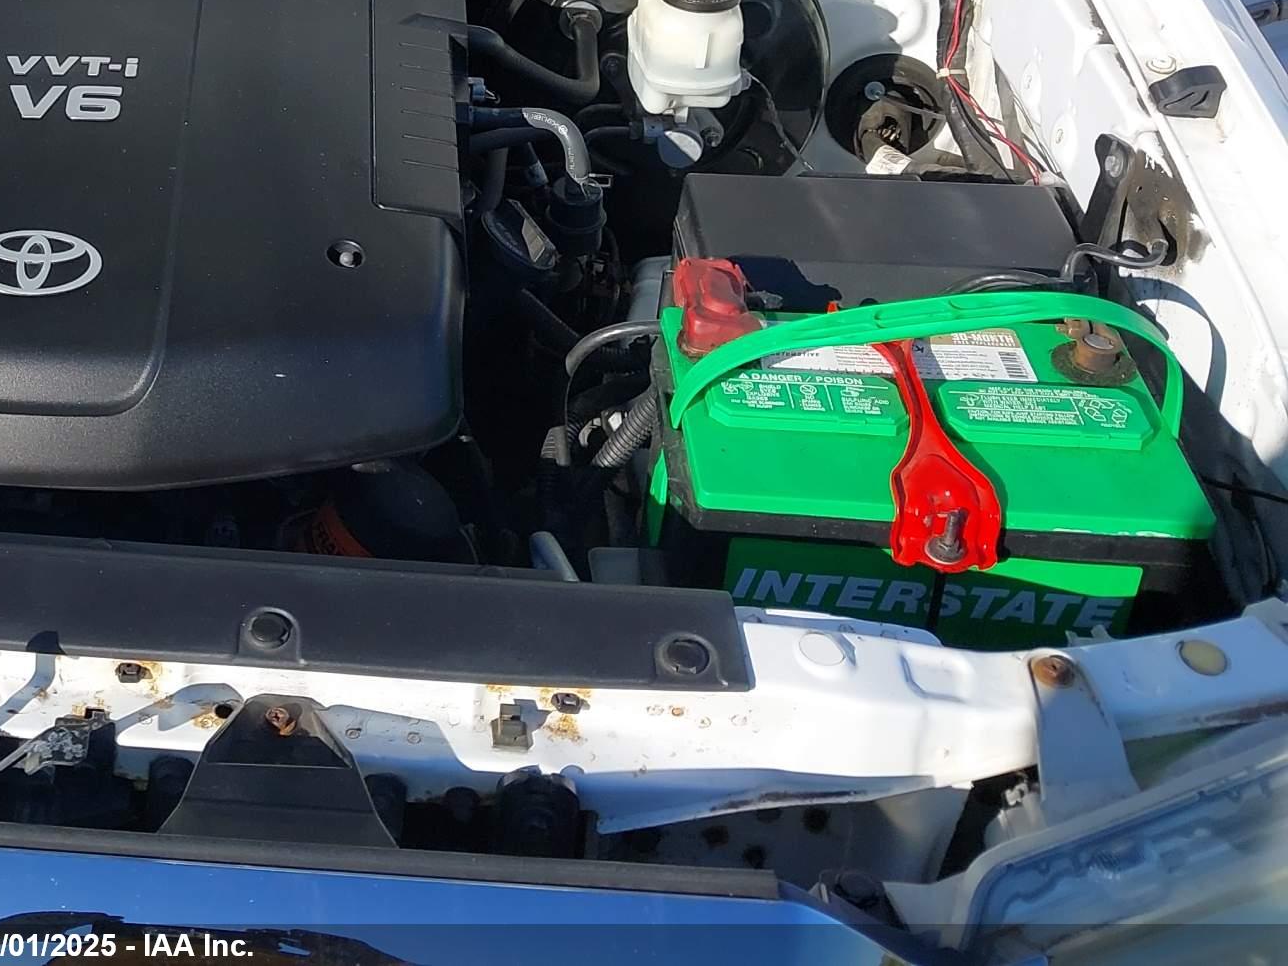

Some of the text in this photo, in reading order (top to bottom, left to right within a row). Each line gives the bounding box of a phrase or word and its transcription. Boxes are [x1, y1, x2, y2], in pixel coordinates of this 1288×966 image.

[6, 55, 140, 78] VVT-i
[9, 84, 124, 121] V6
[751, 373, 802, 382] DANGER
[815, 376, 863, 385] POISON
[732, 568, 1124, 628] INTERSTATE
